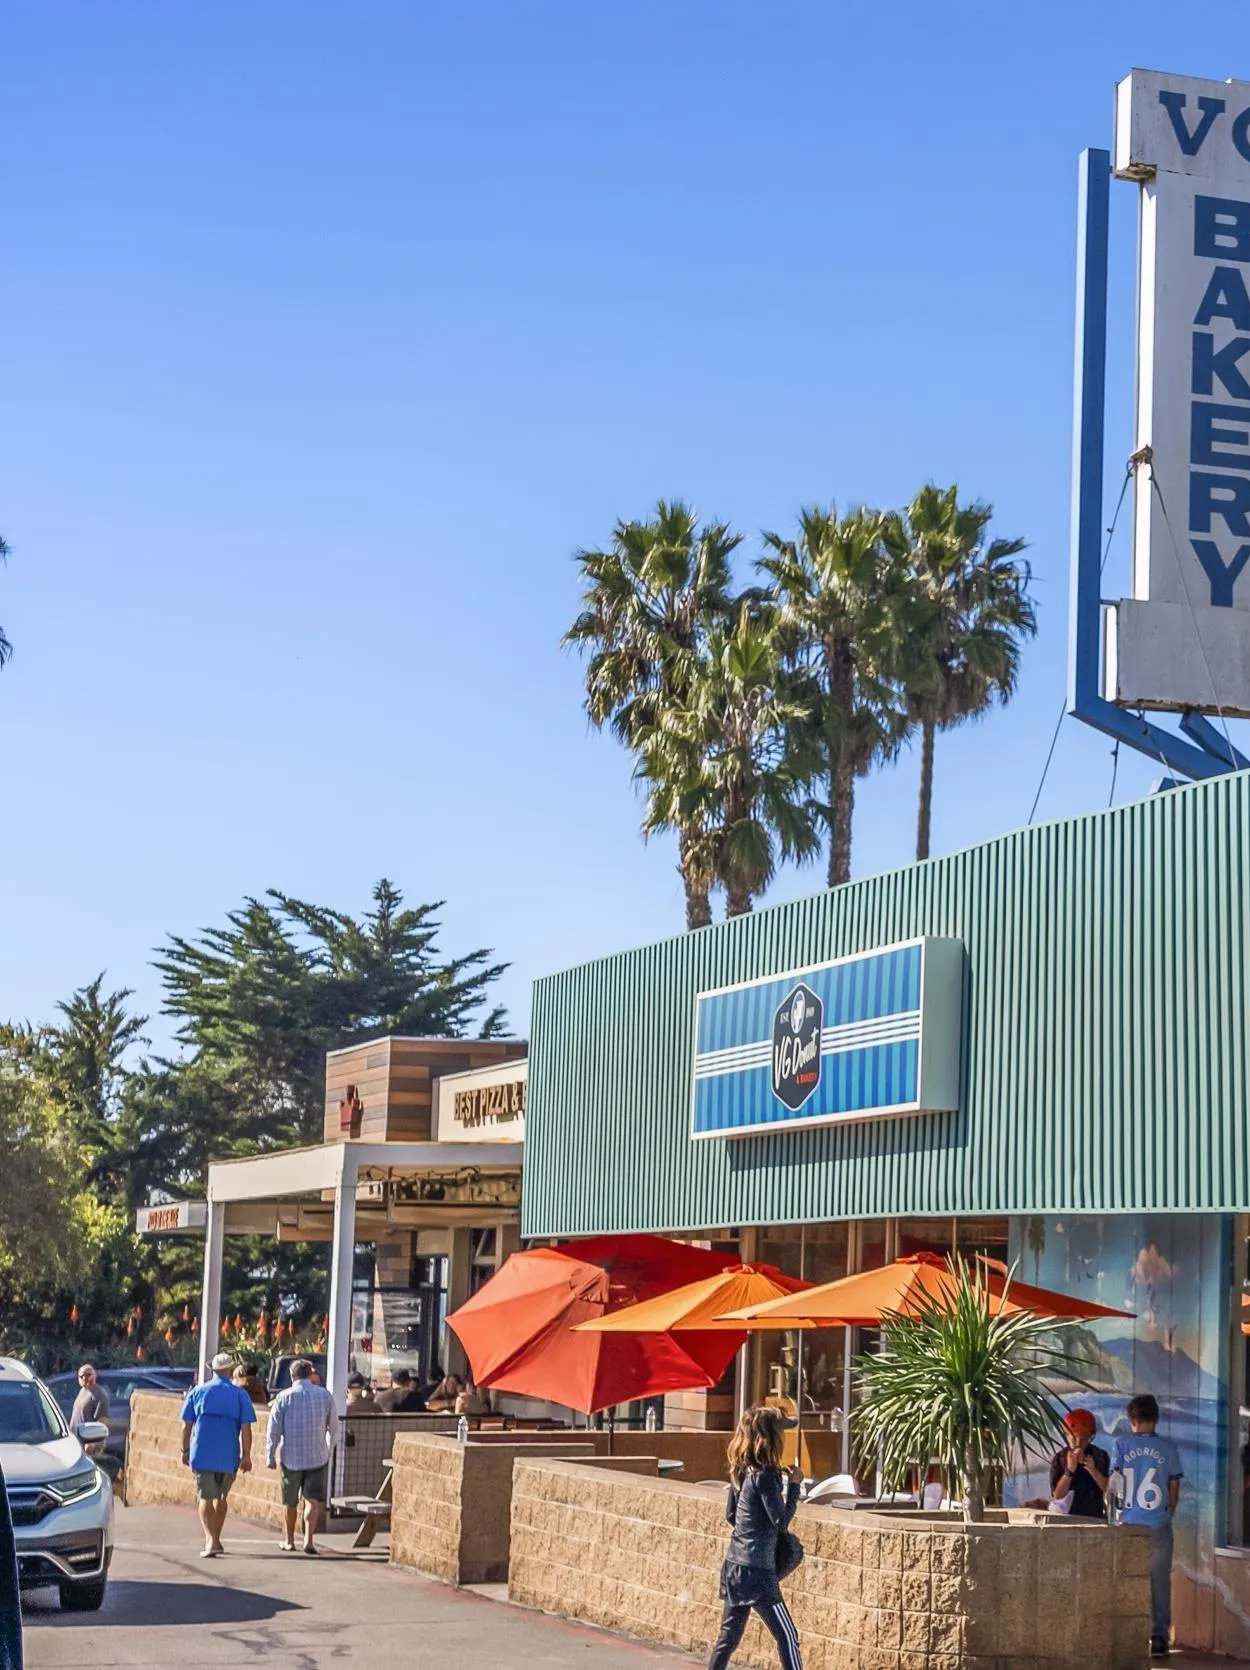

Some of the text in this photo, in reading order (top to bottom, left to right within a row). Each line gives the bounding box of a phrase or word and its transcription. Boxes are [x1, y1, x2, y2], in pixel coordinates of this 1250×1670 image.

[775, 1036, 791, 1090] VG
[454, 1090, 478, 1120] BEST
[480, 1085, 508, 1116] PIZZA
[511, 1082, 518, 1112] &
[1123, 1468, 1163, 1511] 16
